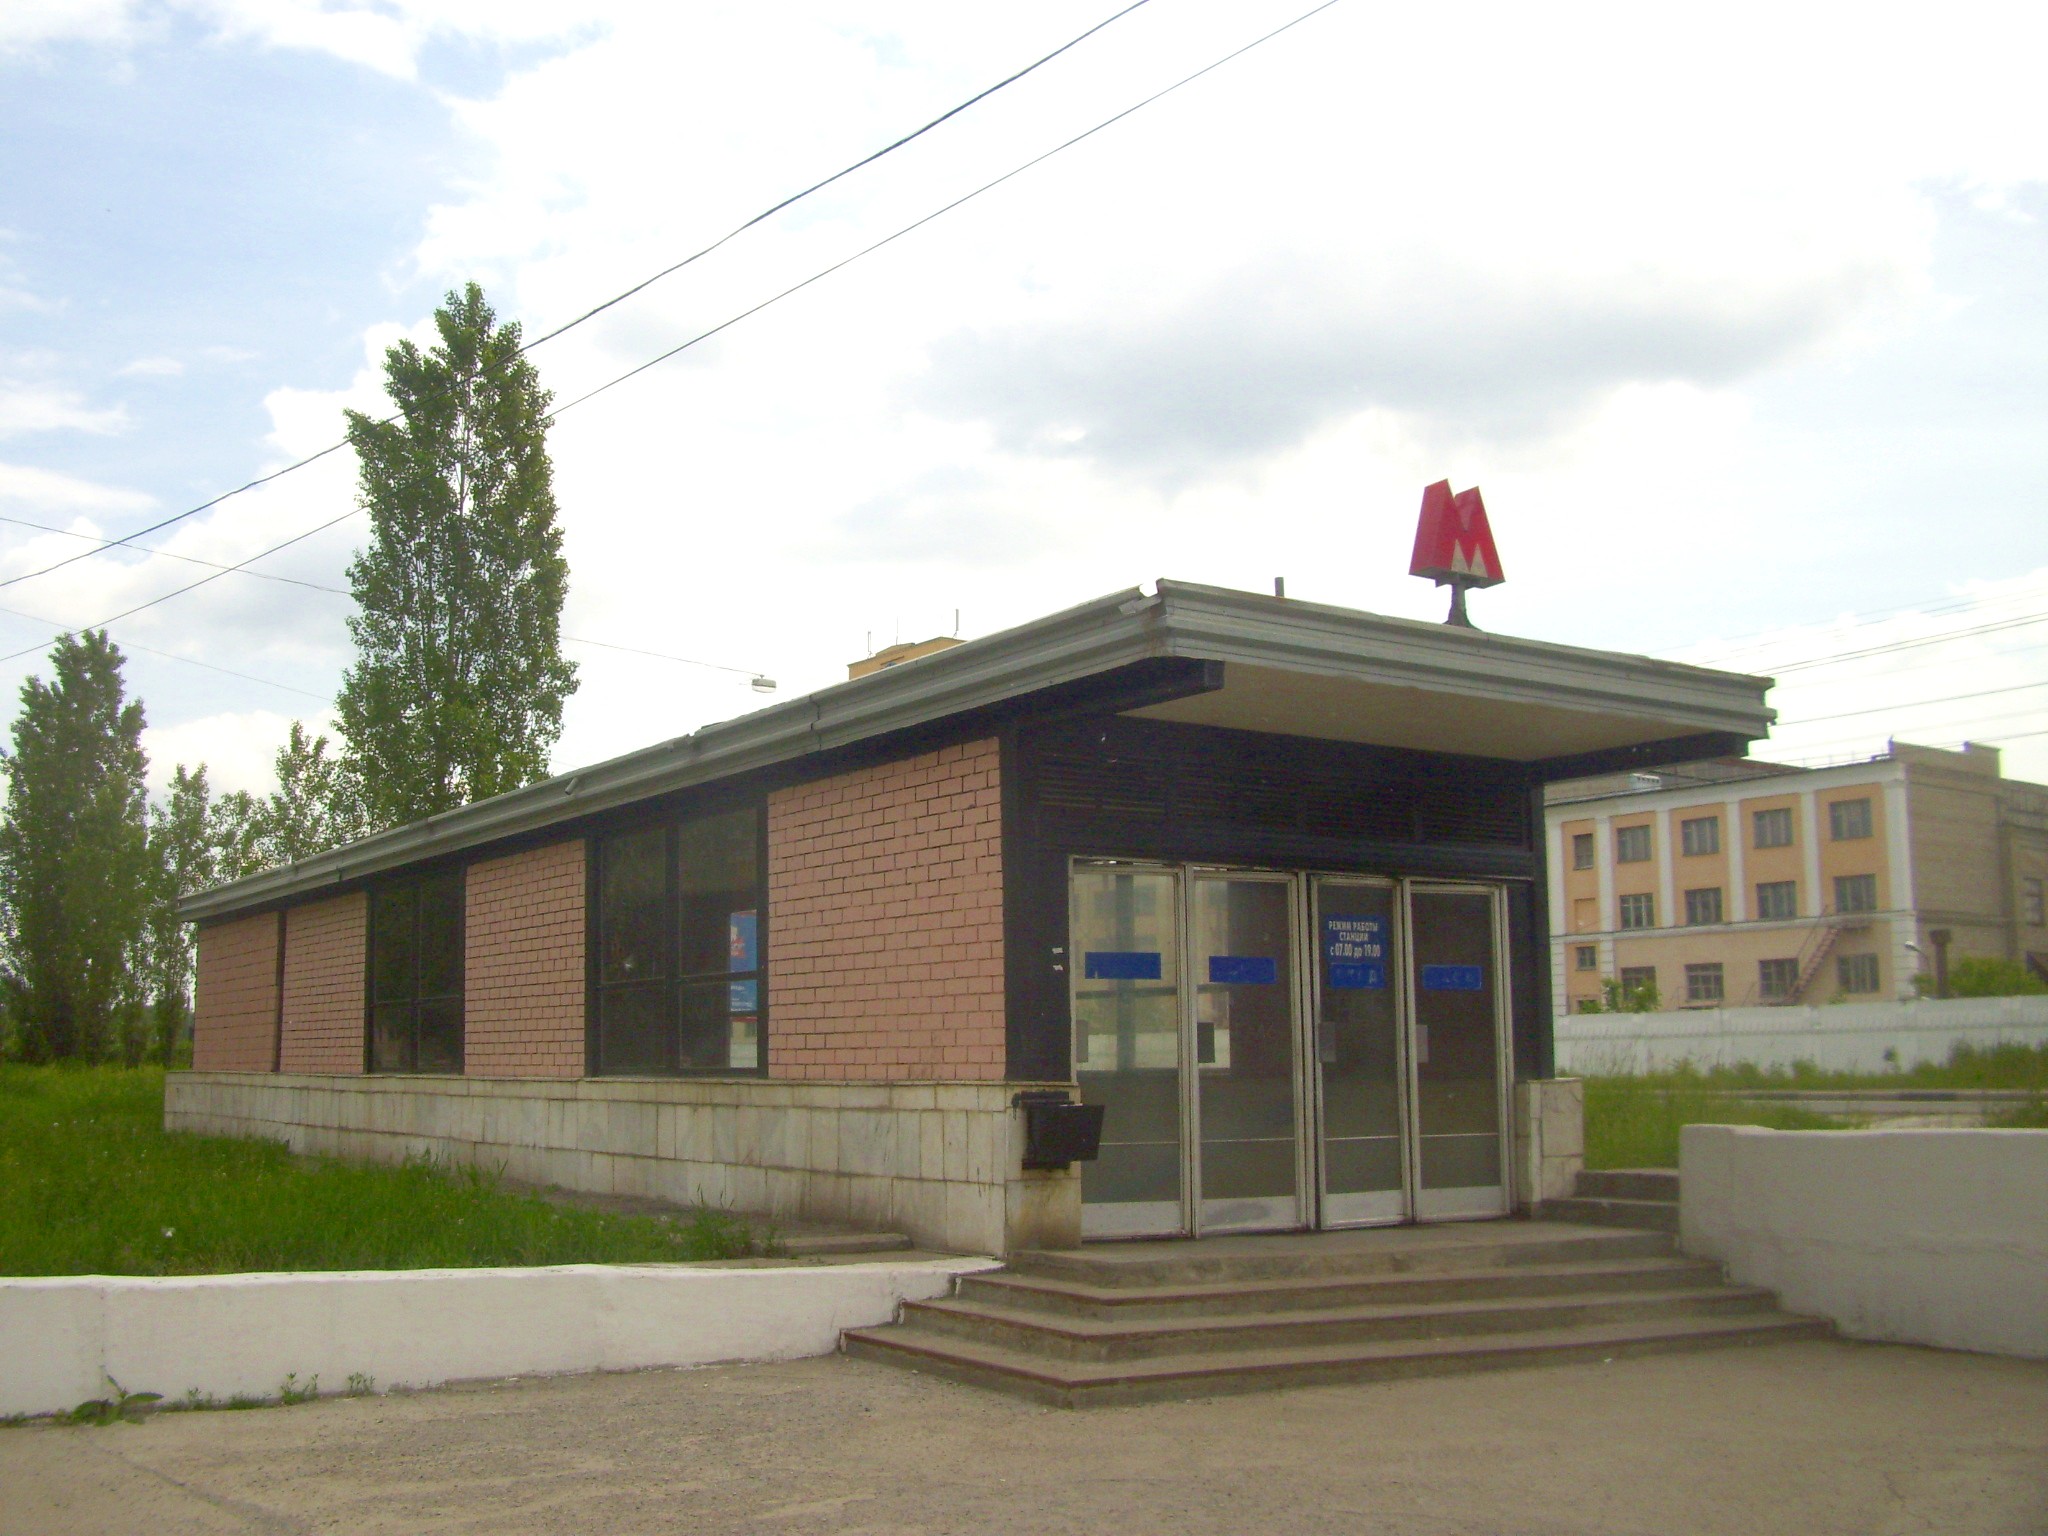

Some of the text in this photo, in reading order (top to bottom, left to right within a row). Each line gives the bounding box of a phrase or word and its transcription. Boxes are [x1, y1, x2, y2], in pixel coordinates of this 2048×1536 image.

[1329, 921, 1378, 931] РЕЖИМ РАБОТЫ
[1339, 932, 1369, 942] СТАНЦИИ
[1335, 943, 1352, 957] 07.00
[1354, 947, 1362, 958] до
[1364, 944, 1380, 957] 19.00
